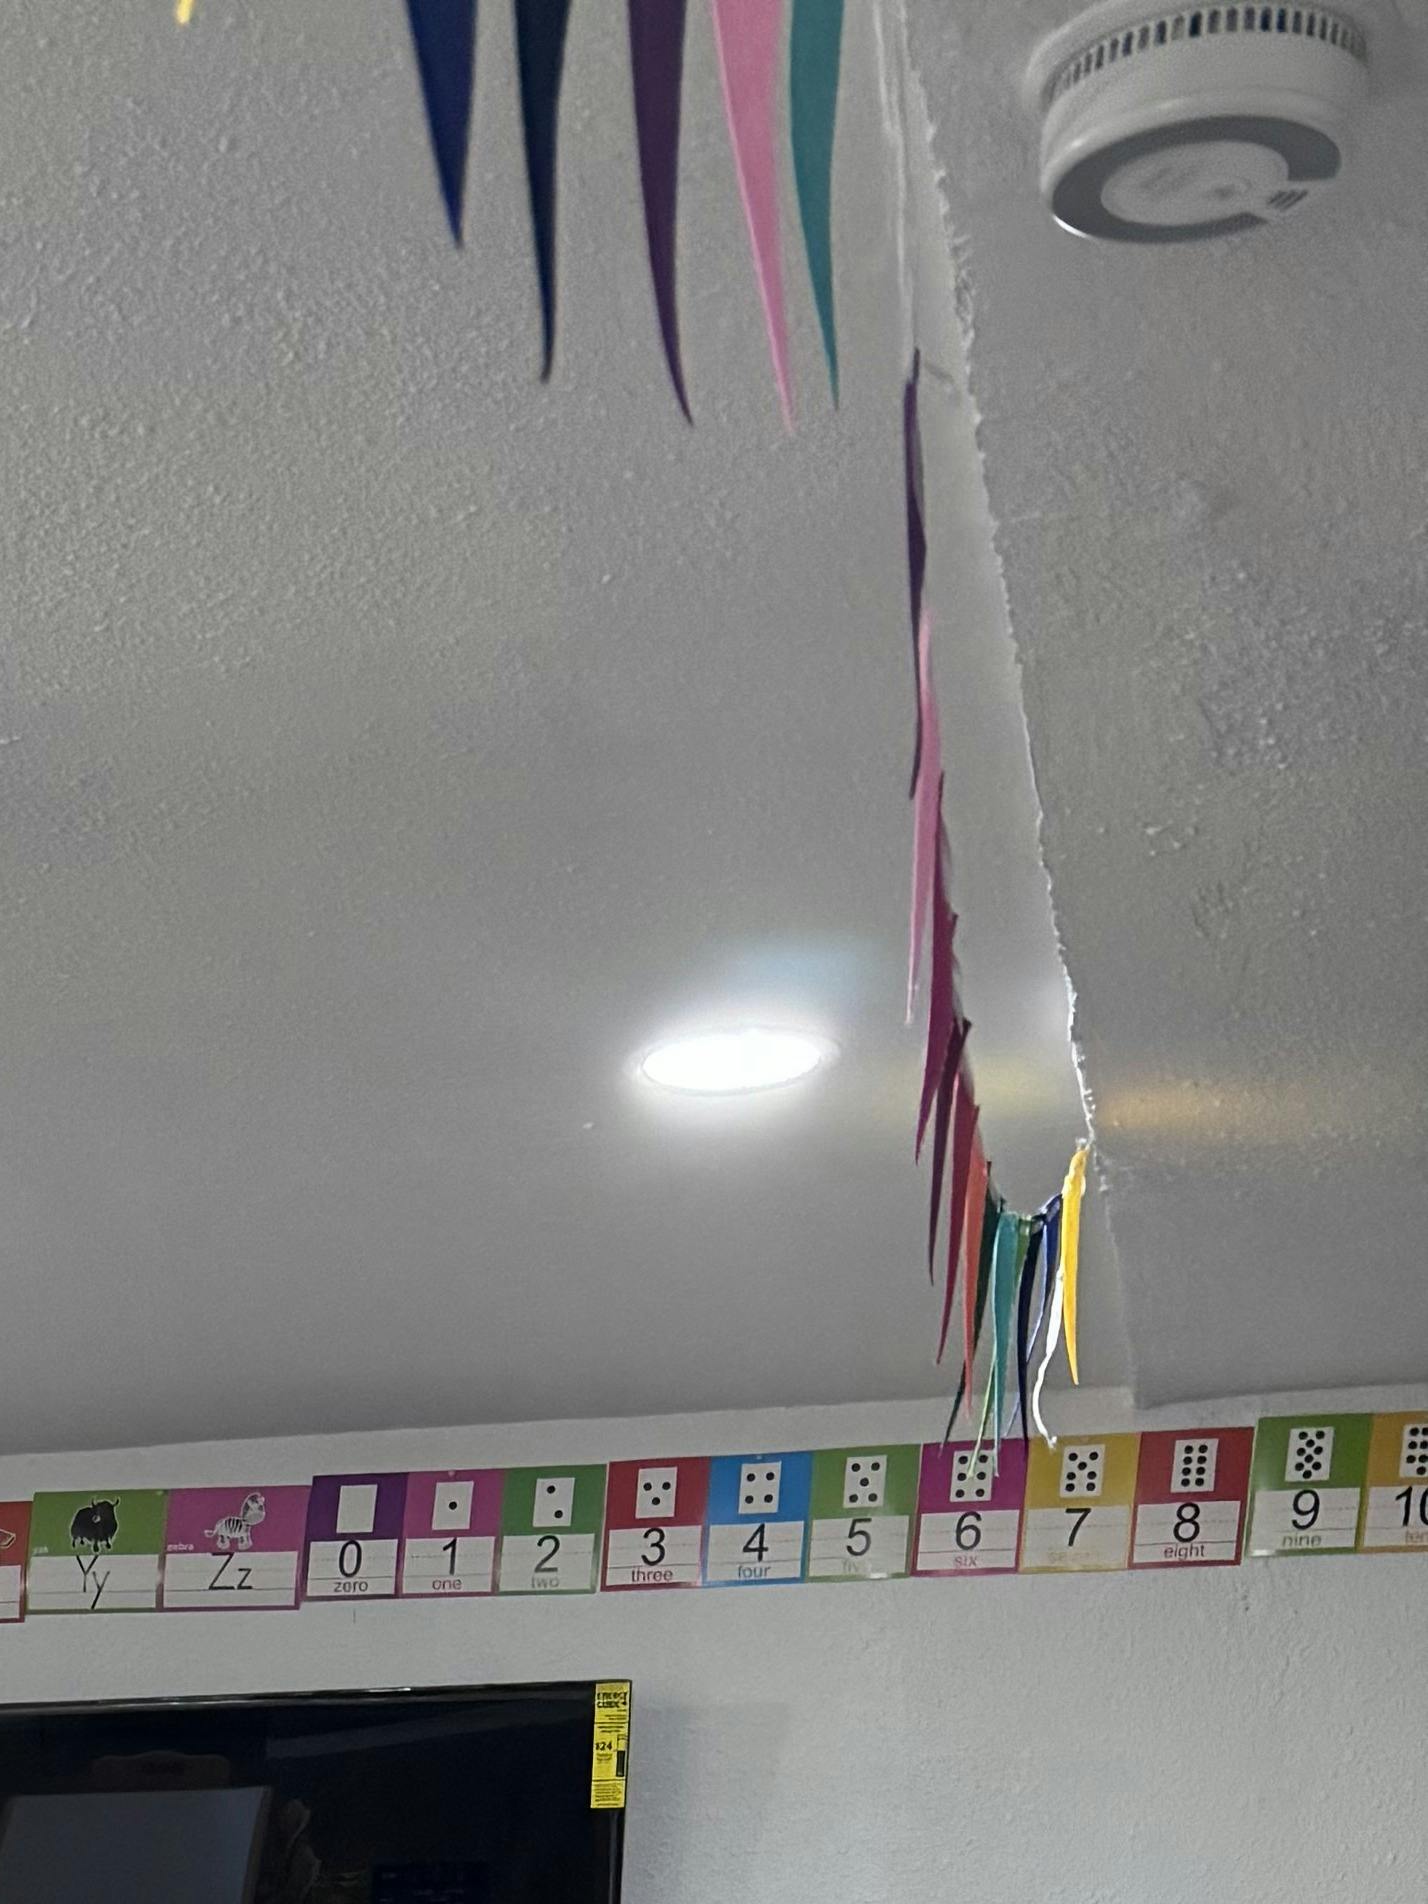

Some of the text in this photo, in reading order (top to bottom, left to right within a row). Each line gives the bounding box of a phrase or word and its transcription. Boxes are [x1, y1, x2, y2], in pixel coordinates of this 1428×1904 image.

[1064, 1507, 1092, 1548] 7
[1172, 1502, 1201, 1543] 8
[1291, 1489, 1320, 1530] 9
[640, 1528, 666, 1566] 3
[741, 1522, 769, 1562] 4
[846, 1517, 873, 1556] 5
[954, 1510, 982, 1550] 6
[1281, 1532, 1322, 1548] nine
[208, 1551, 254, 1590] Zz
[338, 1539, 362, 1578] 0
[441, 1537, 458, 1576] 1
[533, 1535, 561, 1573] 2
[953, 1555, 978, 1569] six
[1163, 1543, 1207, 1560] eight
[75, 1554, 111, 1609] Yy
[431, 1577, 463, 1591] one
[631, 1566, 673, 1584] three
[737, 1563, 771, 1580] four
